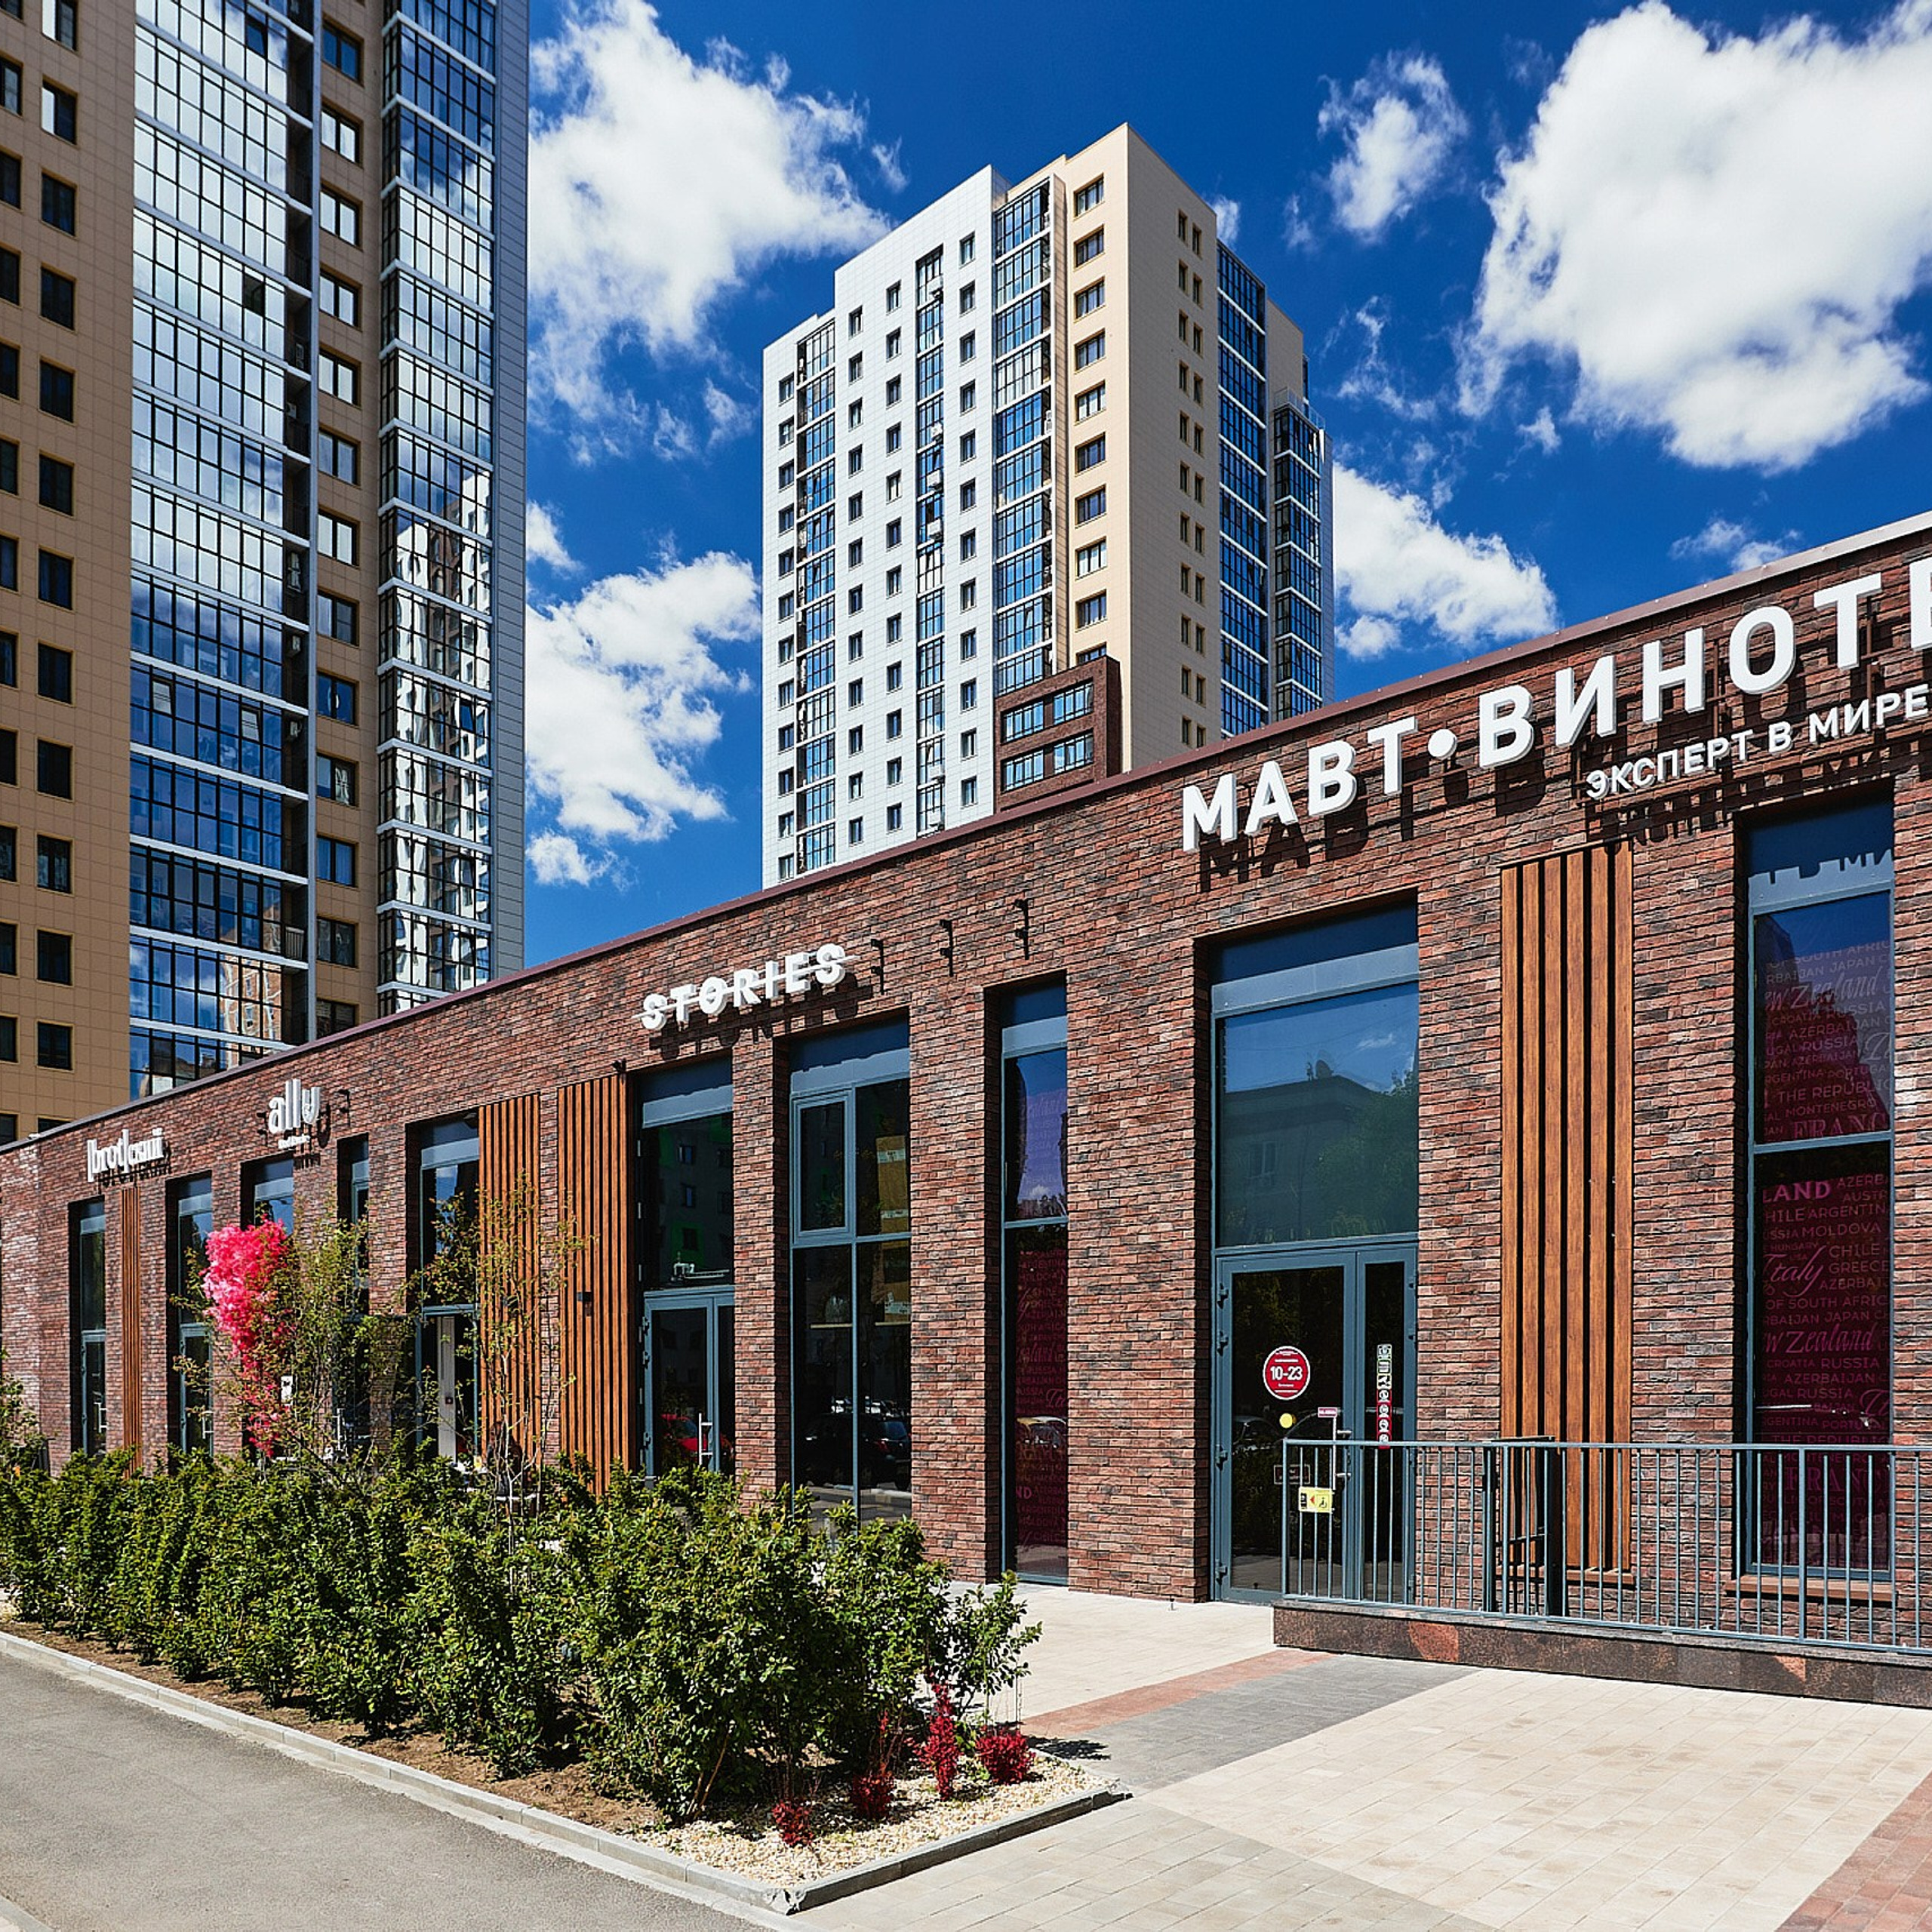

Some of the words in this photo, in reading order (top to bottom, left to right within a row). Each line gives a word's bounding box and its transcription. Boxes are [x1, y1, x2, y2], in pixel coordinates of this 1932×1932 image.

[1586, 728, 1754, 800] ЭКСПЕРТ
[1768, 721, 1794, 756] В
[1809, 683, 1929, 743] МИРЕ
[1829, 956, 1875, 974] JAPAN
[641, 943, 846, 1030] STORIES
[1777, 1088, 1807, 1103] THE
[1837, 1174, 1888, 1189] AZERB
[1807, 1203, 1888, 1219] ARGENTIN
[1801, 1222, 1881, 1238] MOLDOVA
[1829, 1243, 1880, 1258] CHILE
[1789, 1297, 1837, 1309] SOUTH
[1825, 1311, 1869, 1322] JAPAN
[1767, 1358, 1816, 1368] CROATIA
[1821, 1357, 1880, 1369] RUSSIA
[1270, 1365, 1303, 1381] 10-23
[1785, 1373, 1875, 1384] AZERBAIJAN
[1798, 1388, 1854, 1399] RUSSIA
